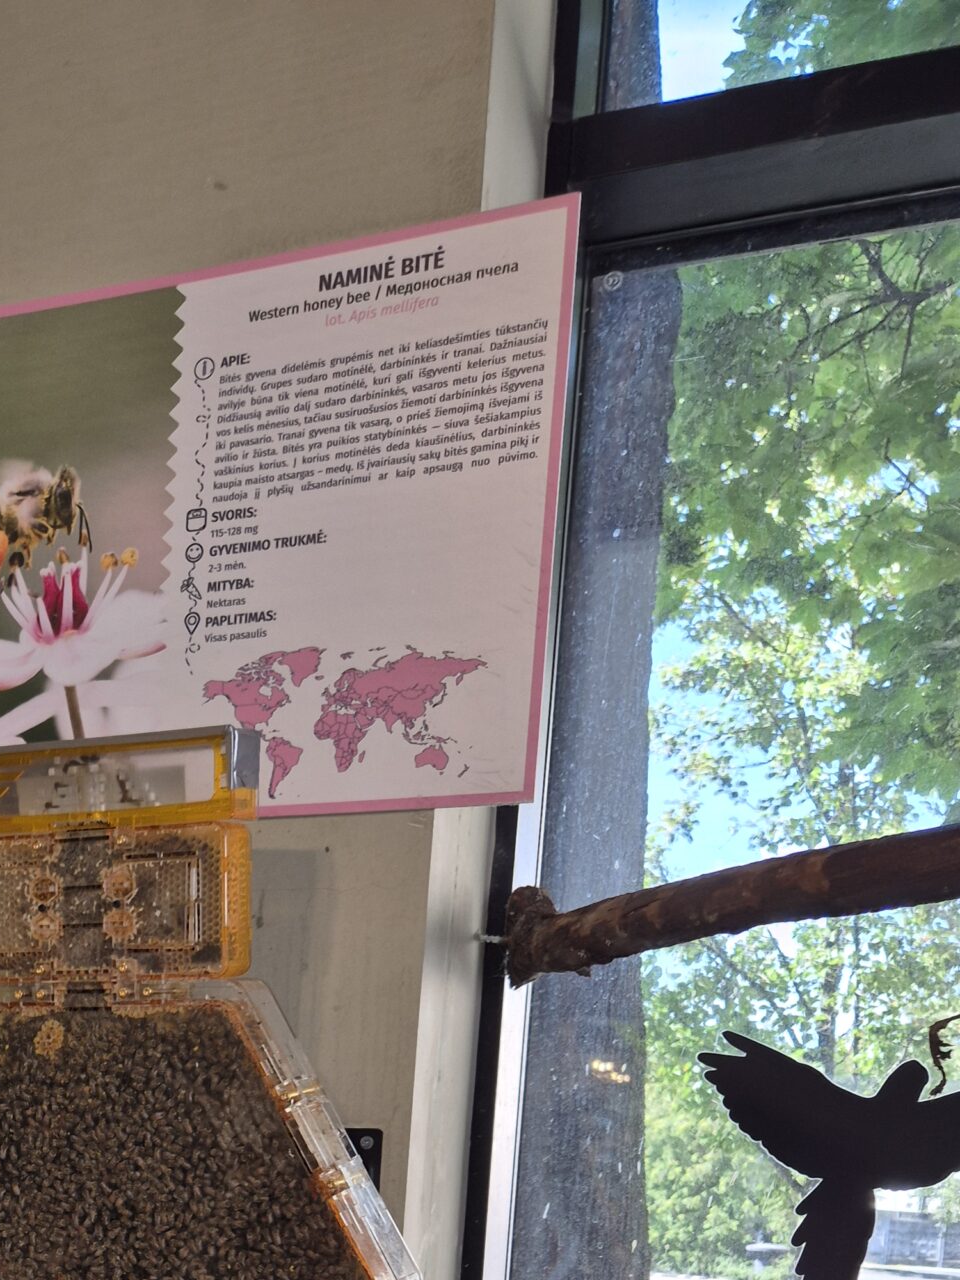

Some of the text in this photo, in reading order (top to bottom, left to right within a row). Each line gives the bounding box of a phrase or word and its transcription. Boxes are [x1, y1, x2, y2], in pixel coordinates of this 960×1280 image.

[318, 245, 445, 292] NAMINĖ BITĖ
[248, 304, 299, 323] Western
[303, 296, 344, 313] honey
[346, 291, 371, 305] bee
[385, 271, 472, 297] Медоносная
[476, 262, 519, 280] пчела
[348, 305, 377, 325] Apis
[380, 296, 440, 317] mellifera
[217, 398, 246, 411] avilyje
[277, 391, 290, 402] tik
[294, 388, 319, 399] viena
[324, 378, 368, 394] motinėlė,
[372, 373, 392, 386] kuri
[396, 369, 414, 384] gali
[418, 361, 462, 379] išgyventi
[467, 355, 507, 370] kelerius
[512, 349, 546, 362] metus.
[219, 373, 242, 385] Bitės
[245, 368, 277, 383] gyvena
[281, 358, 326, 374] didelėmis
[329, 350, 374, 368] grupėmis
[378, 347, 394, 357] net
[398, 342, 411, 354] iki
[415, 329, 491, 351] keliasdešimties
[220, 353, 251, 368] APIE:
[260, 379, 293, 391] Grupes
[296, 373, 328, 385] sudaro
[332, 363, 376, 379] motinėlė,
[380, 352, 437, 371] darbininkės
[441, 350, 450, 360] ir
[453, 343, 485, 358] tranai.
[489, 331, 547, 352] Dažniausiai
[216, 428, 232, 437] vos
[233, 423, 254, 435] kelis
[256, 418, 302, 431] mėnesius,
[304, 412, 332, 425] tačiau
[400, 393, 437, 409] žiemoti
[439, 384, 498, 403] darbininkės
[500, 378, 544, 394] išgyvena
[265, 404, 290, 417] avilio
[293, 400, 311, 413] dalį
[314, 397, 347, 409] sudaro
[349, 385, 408, 404] darbininkės,
[412, 380, 449, 393] vasaros
[452, 375, 478, 386] metu
[481, 371, 497, 384] jos
[501, 363, 545, 379] išgyvena
[214, 452, 239, 464] avilio
[242, 450, 249, 460] ir
[282, 442, 305, 454] Bitės
[308, 441, 323, 453] yra
[326, 435, 360, 450] puikios
[364, 424, 428, 442] statybininkės
[444, 419, 470, 430] siuva
[474, 406, 542, 425] šešiakampius
[215, 390, 543, 451] iki pavasario. Tranai gyvena tik vasarą, o prieš žiemojimą išvejami iš
[213, 464, 255, 477] vaškinius
[258, 459, 289, 471] korius.
[302, 453, 330, 465] korius
[335, 445, 381, 460] motinėlės
[386, 440, 410, 452] deda
[415, 431, 476, 448] kiaušinėlius,
[481, 420, 541, 438] darbininkės
[213, 478, 242, 490] kaupia
[244, 474, 275, 486] maisto
[277, 469, 315, 482] atsargas
[325, 463, 354, 475] medų.
[356, 460, 365, 470] Iš
[366, 453, 416, 471] įvairiausių
[418, 450, 441, 462] sakų
[443, 445, 468, 458] bitės
[470, 440, 507, 456] gamina
[510, 435, 529, 450] pikį
[531, 434, 540, 444] ir
[212, 490, 248, 503] naudoja
[267, 484, 294, 498] plyšių
[378, 472, 389, 481] ar
[395, 466, 416, 479] kaip
[423, 462, 463, 476] apsaugą
[471, 458, 491, 468] nuo
[210, 525, 259, 538] 115-128 mg
[211, 506, 257, 523] SVORIS:
[209, 529, 327, 557] GYVENIMO TRUKMĖ:
[207, 577, 254, 593] MITYBA:
[208, 560, 246, 573] 2-3 mėn.
[205, 610, 277, 628] PAPLITIMAS:
[206, 597, 246, 609] Nektaras
[204, 628, 267, 643] Visas pasaulis
